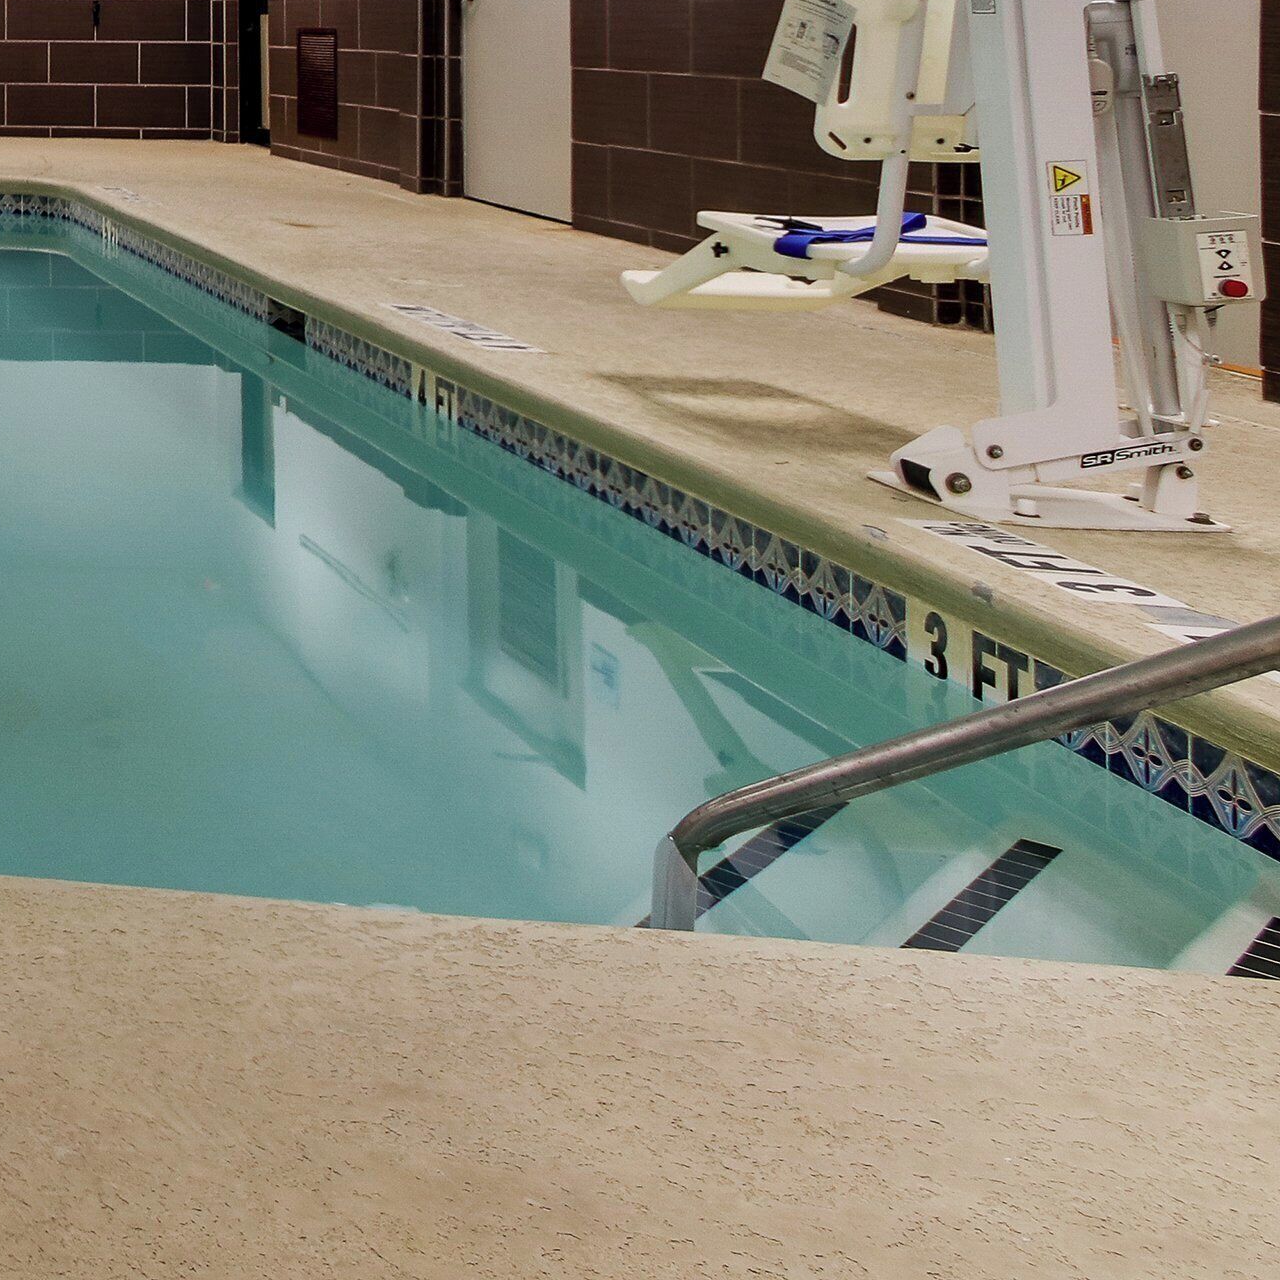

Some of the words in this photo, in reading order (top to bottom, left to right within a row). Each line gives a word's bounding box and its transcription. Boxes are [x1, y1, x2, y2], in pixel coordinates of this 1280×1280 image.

[435, 373, 456, 420] FT
[966, 544, 1105, 575] FT
[1055, 580, 1159, 598] 3
[924, 610, 948, 680] 3
[971, 629, 1029, 703] FT
